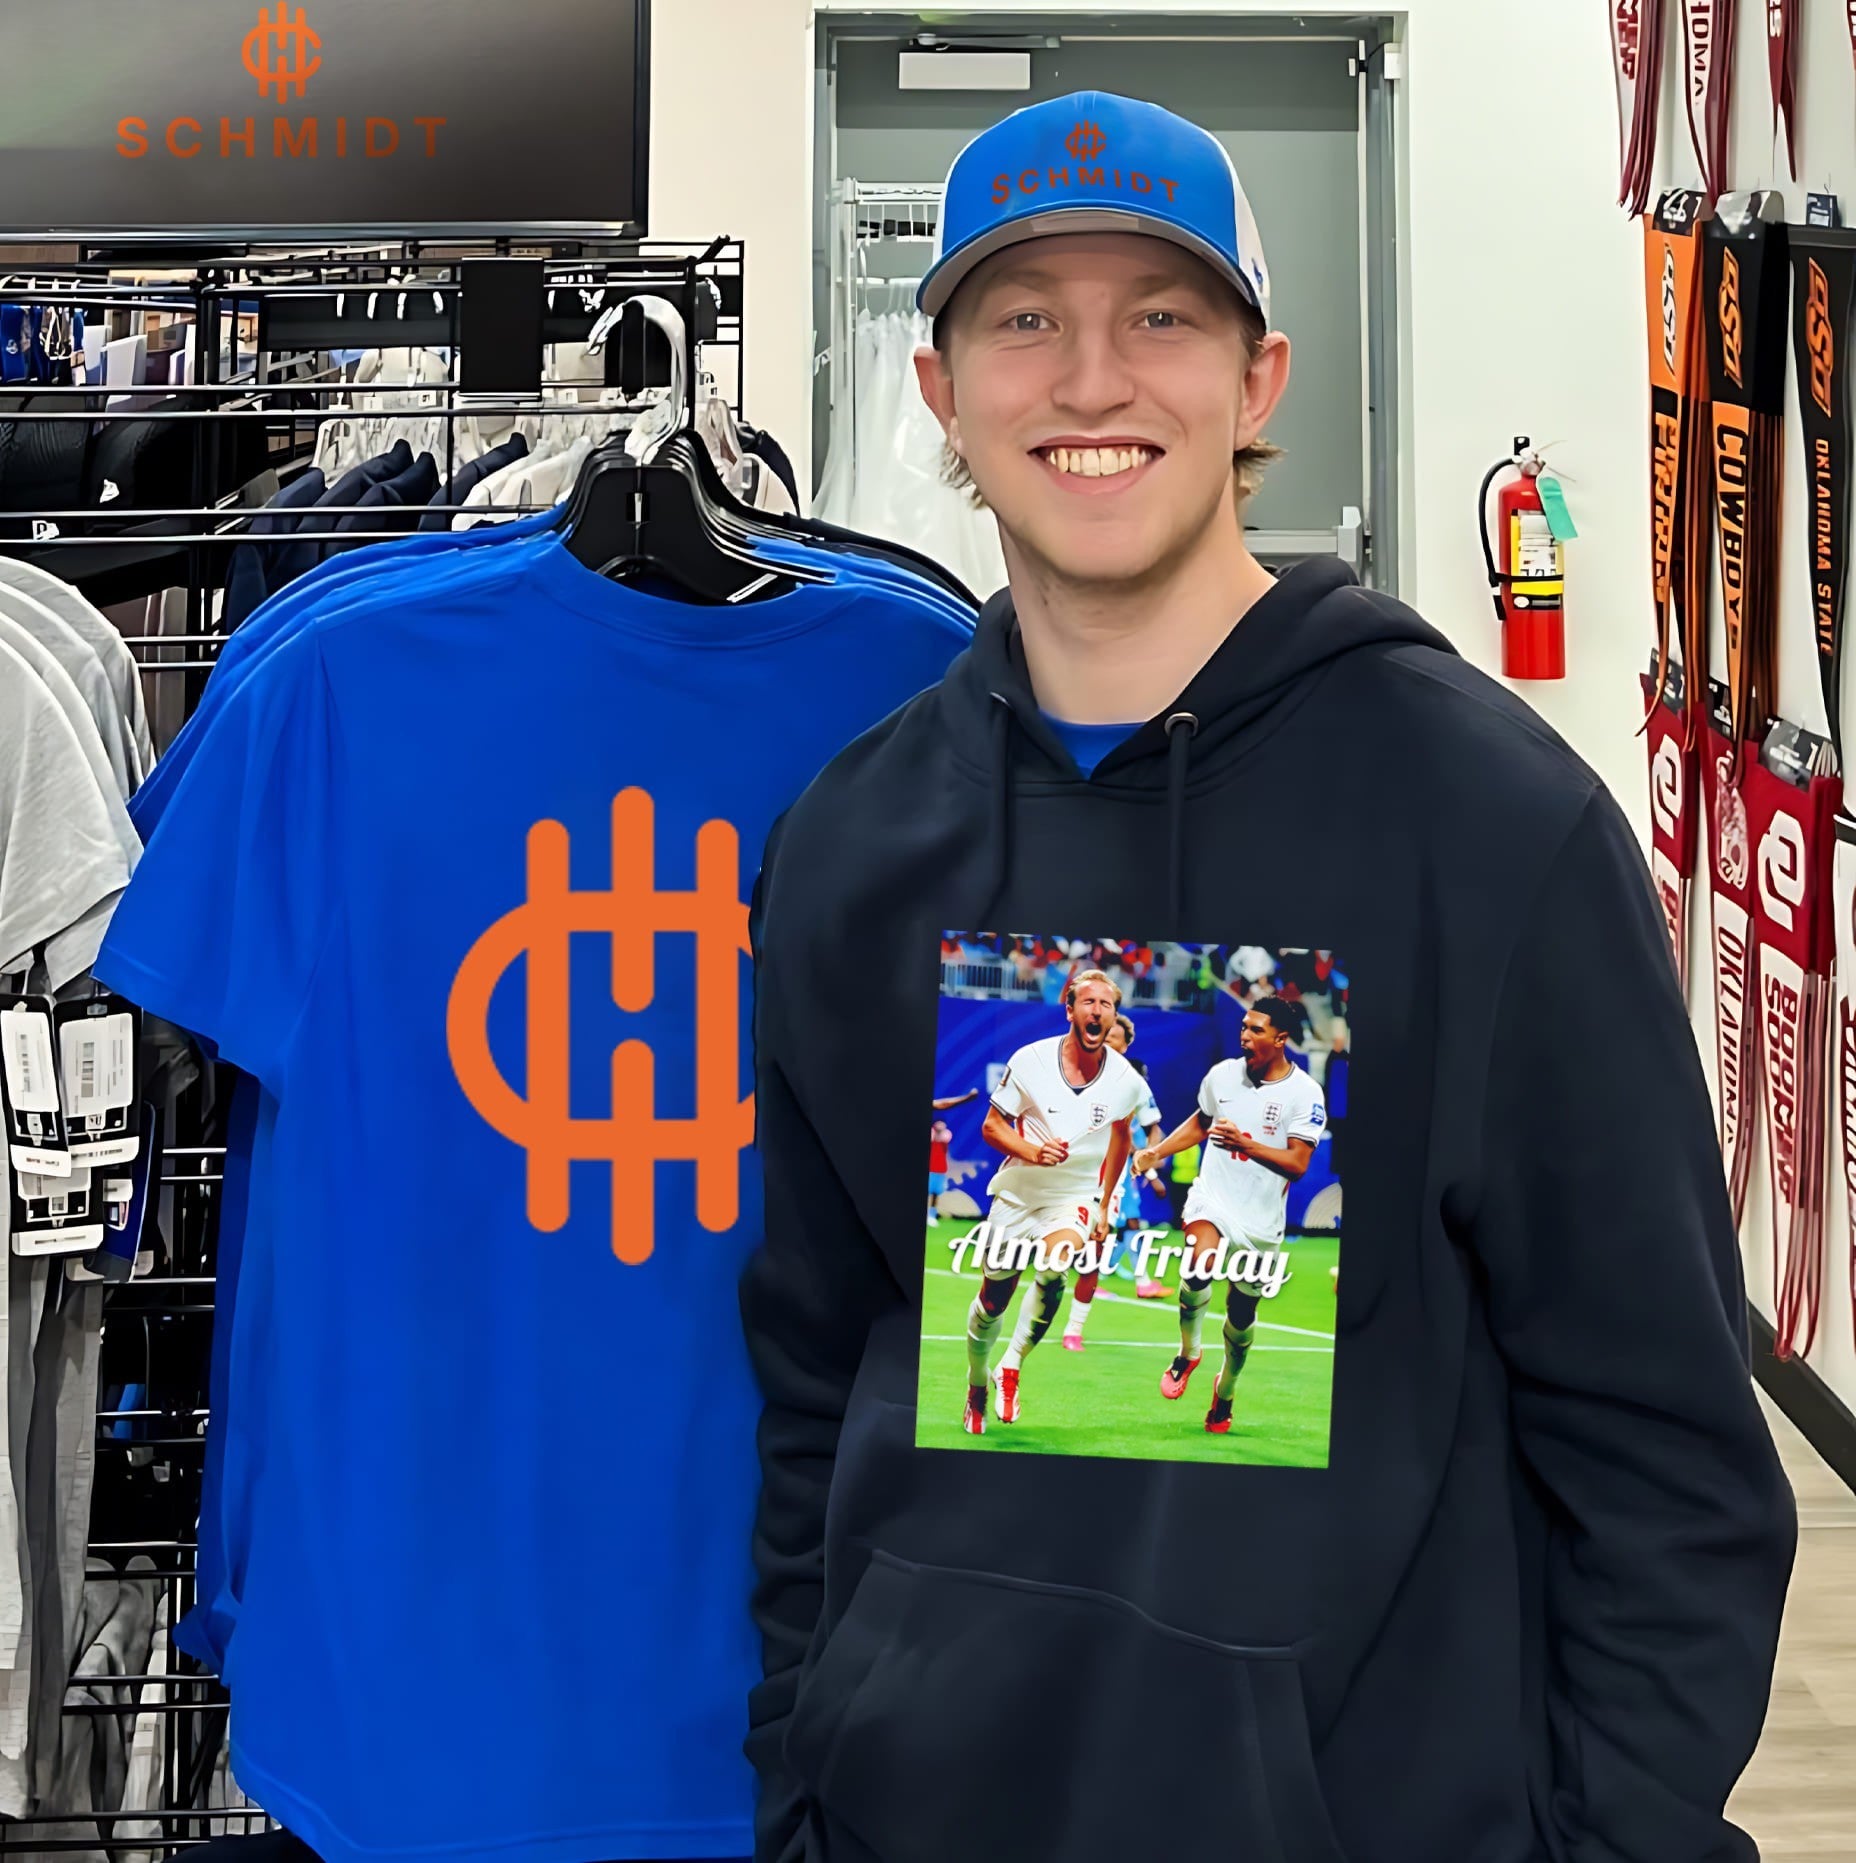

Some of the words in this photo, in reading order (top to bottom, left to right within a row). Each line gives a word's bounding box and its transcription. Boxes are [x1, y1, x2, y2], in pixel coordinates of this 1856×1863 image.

[116, 117, 447, 158] SCHMIDT
[991, 166, 1179, 204] SCHMIDT
[1815, 438, 1832, 570] OKLAHOMA
[948, 1222, 1120, 1275] Almost
[1130, 1230, 1293, 1299] Friday
